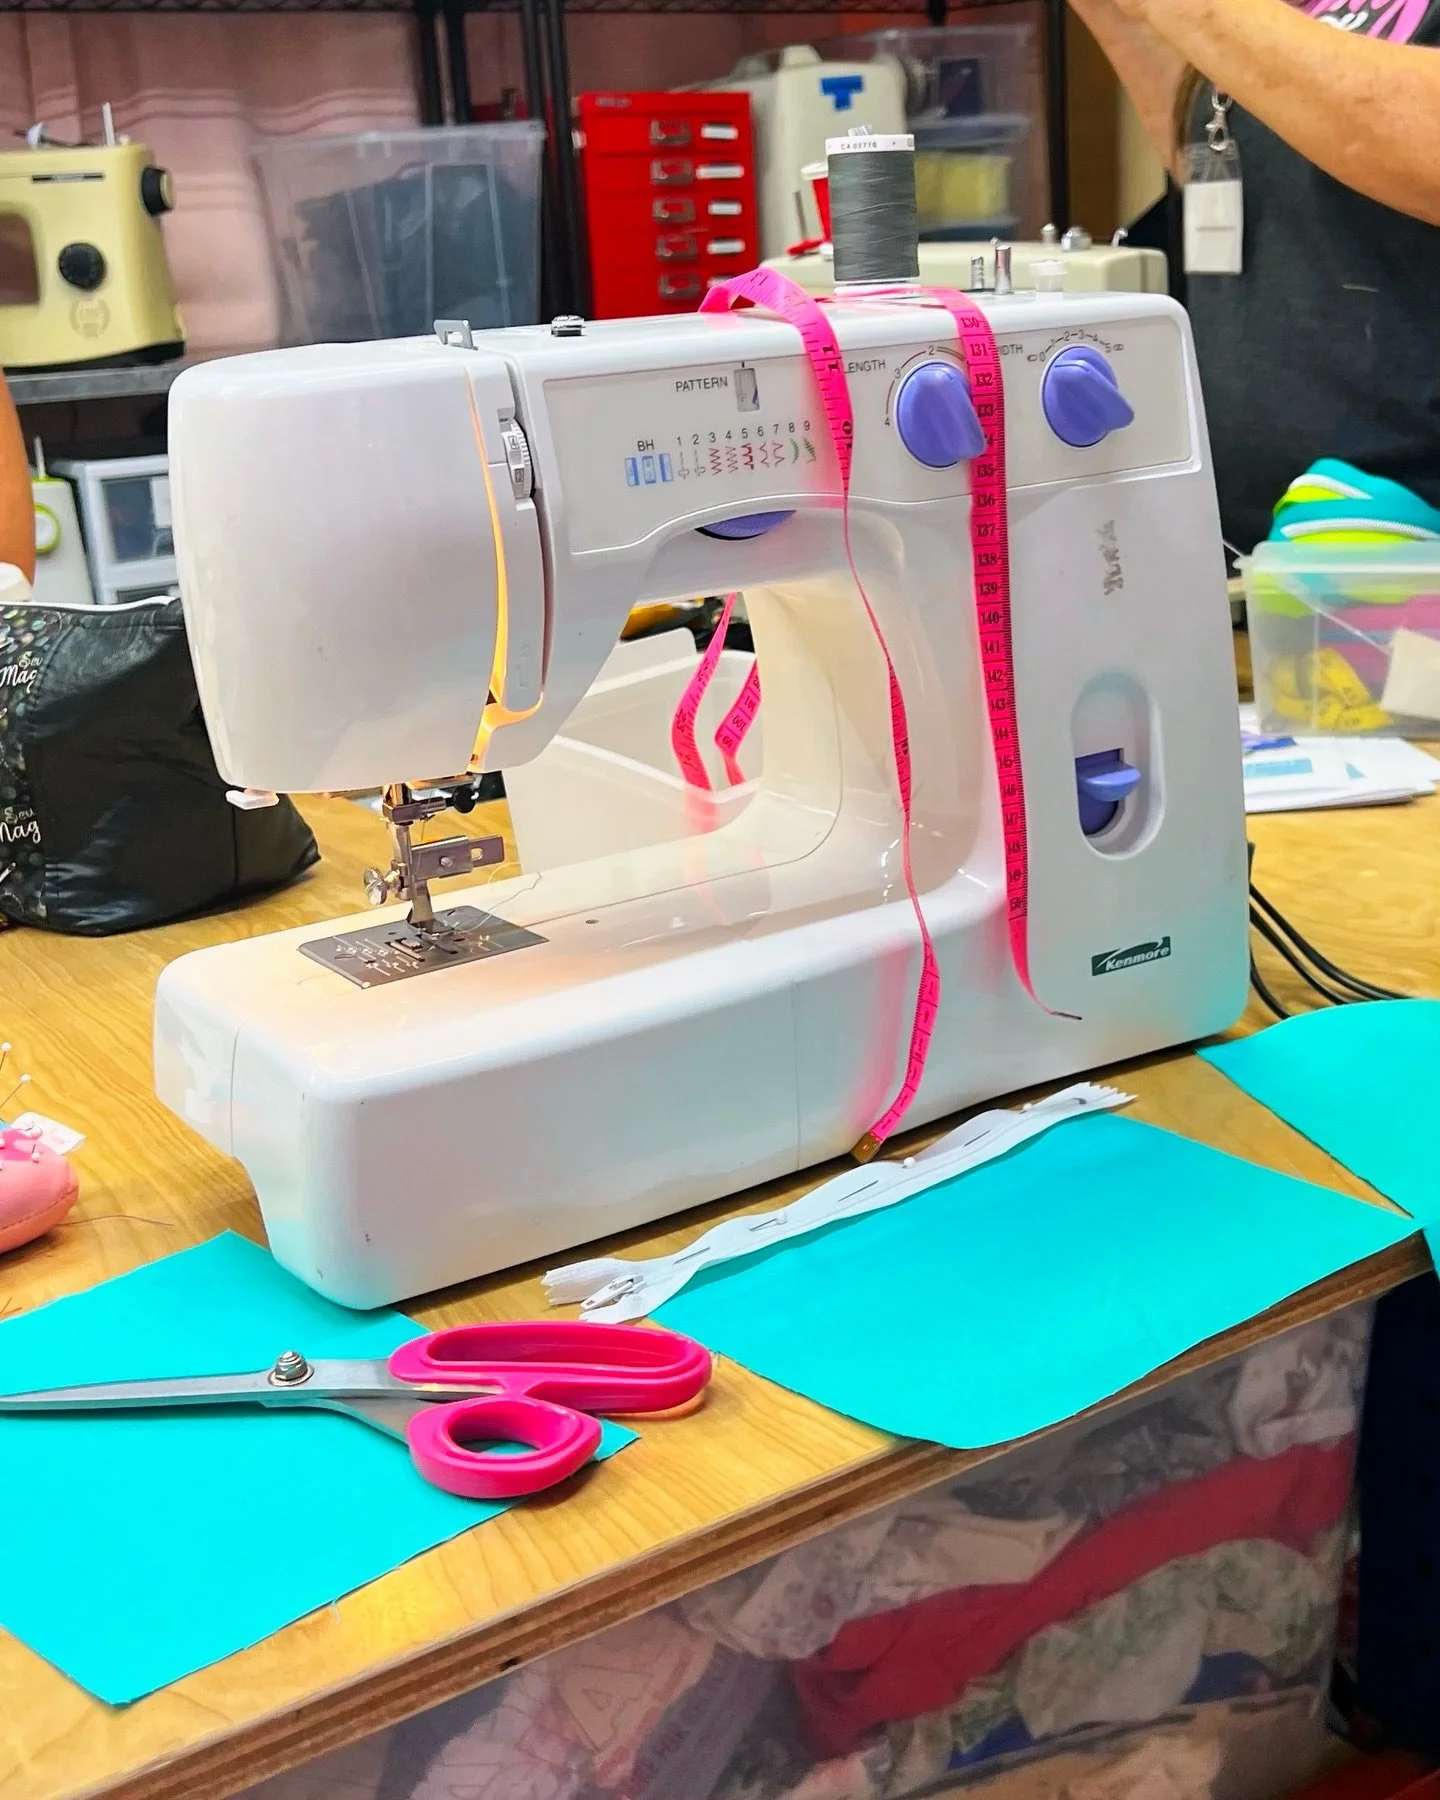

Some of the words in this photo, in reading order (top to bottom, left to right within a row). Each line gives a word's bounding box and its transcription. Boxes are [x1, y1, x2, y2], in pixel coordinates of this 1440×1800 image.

[961, 316, 980, 328] 130
[1064, 330, 1070, 341] 2
[1078, 329, 1085, 340] 3
[928, 345, 935, 356] 2
[969, 343, 988, 357] 131
[1000, 343, 1023, 356] DTH
[894, 369, 902, 379] 3
[974, 373, 994, 387] 132
[675, 376, 728, 392] PATTERN
[976, 403, 994, 417] 133
[884, 417, 890, 426] 4
[677, 437, 682, 446] 1
[693, 434, 699, 445] 2
[708, 432, 716, 443] 3
[725, 430, 732, 440] 4
[741, 428, 748, 439] 5
[757, 426, 764, 437] 6
[773, 424, 779, 434] 7
[788, 422, 795, 432] 8
[804, 420, 810, 431] 9
[637, 440, 655, 452] BH
[976, 464, 995, 478] 135
[976, 494, 995, 508] 136
[976, 523, 995, 537] 137
[977, 553, 997, 567] 138
[979, 582, 998, 596] 139
[982, 611, 1000, 624] 140
[984, 641, 1000, 654] 141
[987, 669, 1003, 683] 142
[991, 698, 1006, 711] 143
[1105, 946, 1169, 972] Kenmore
